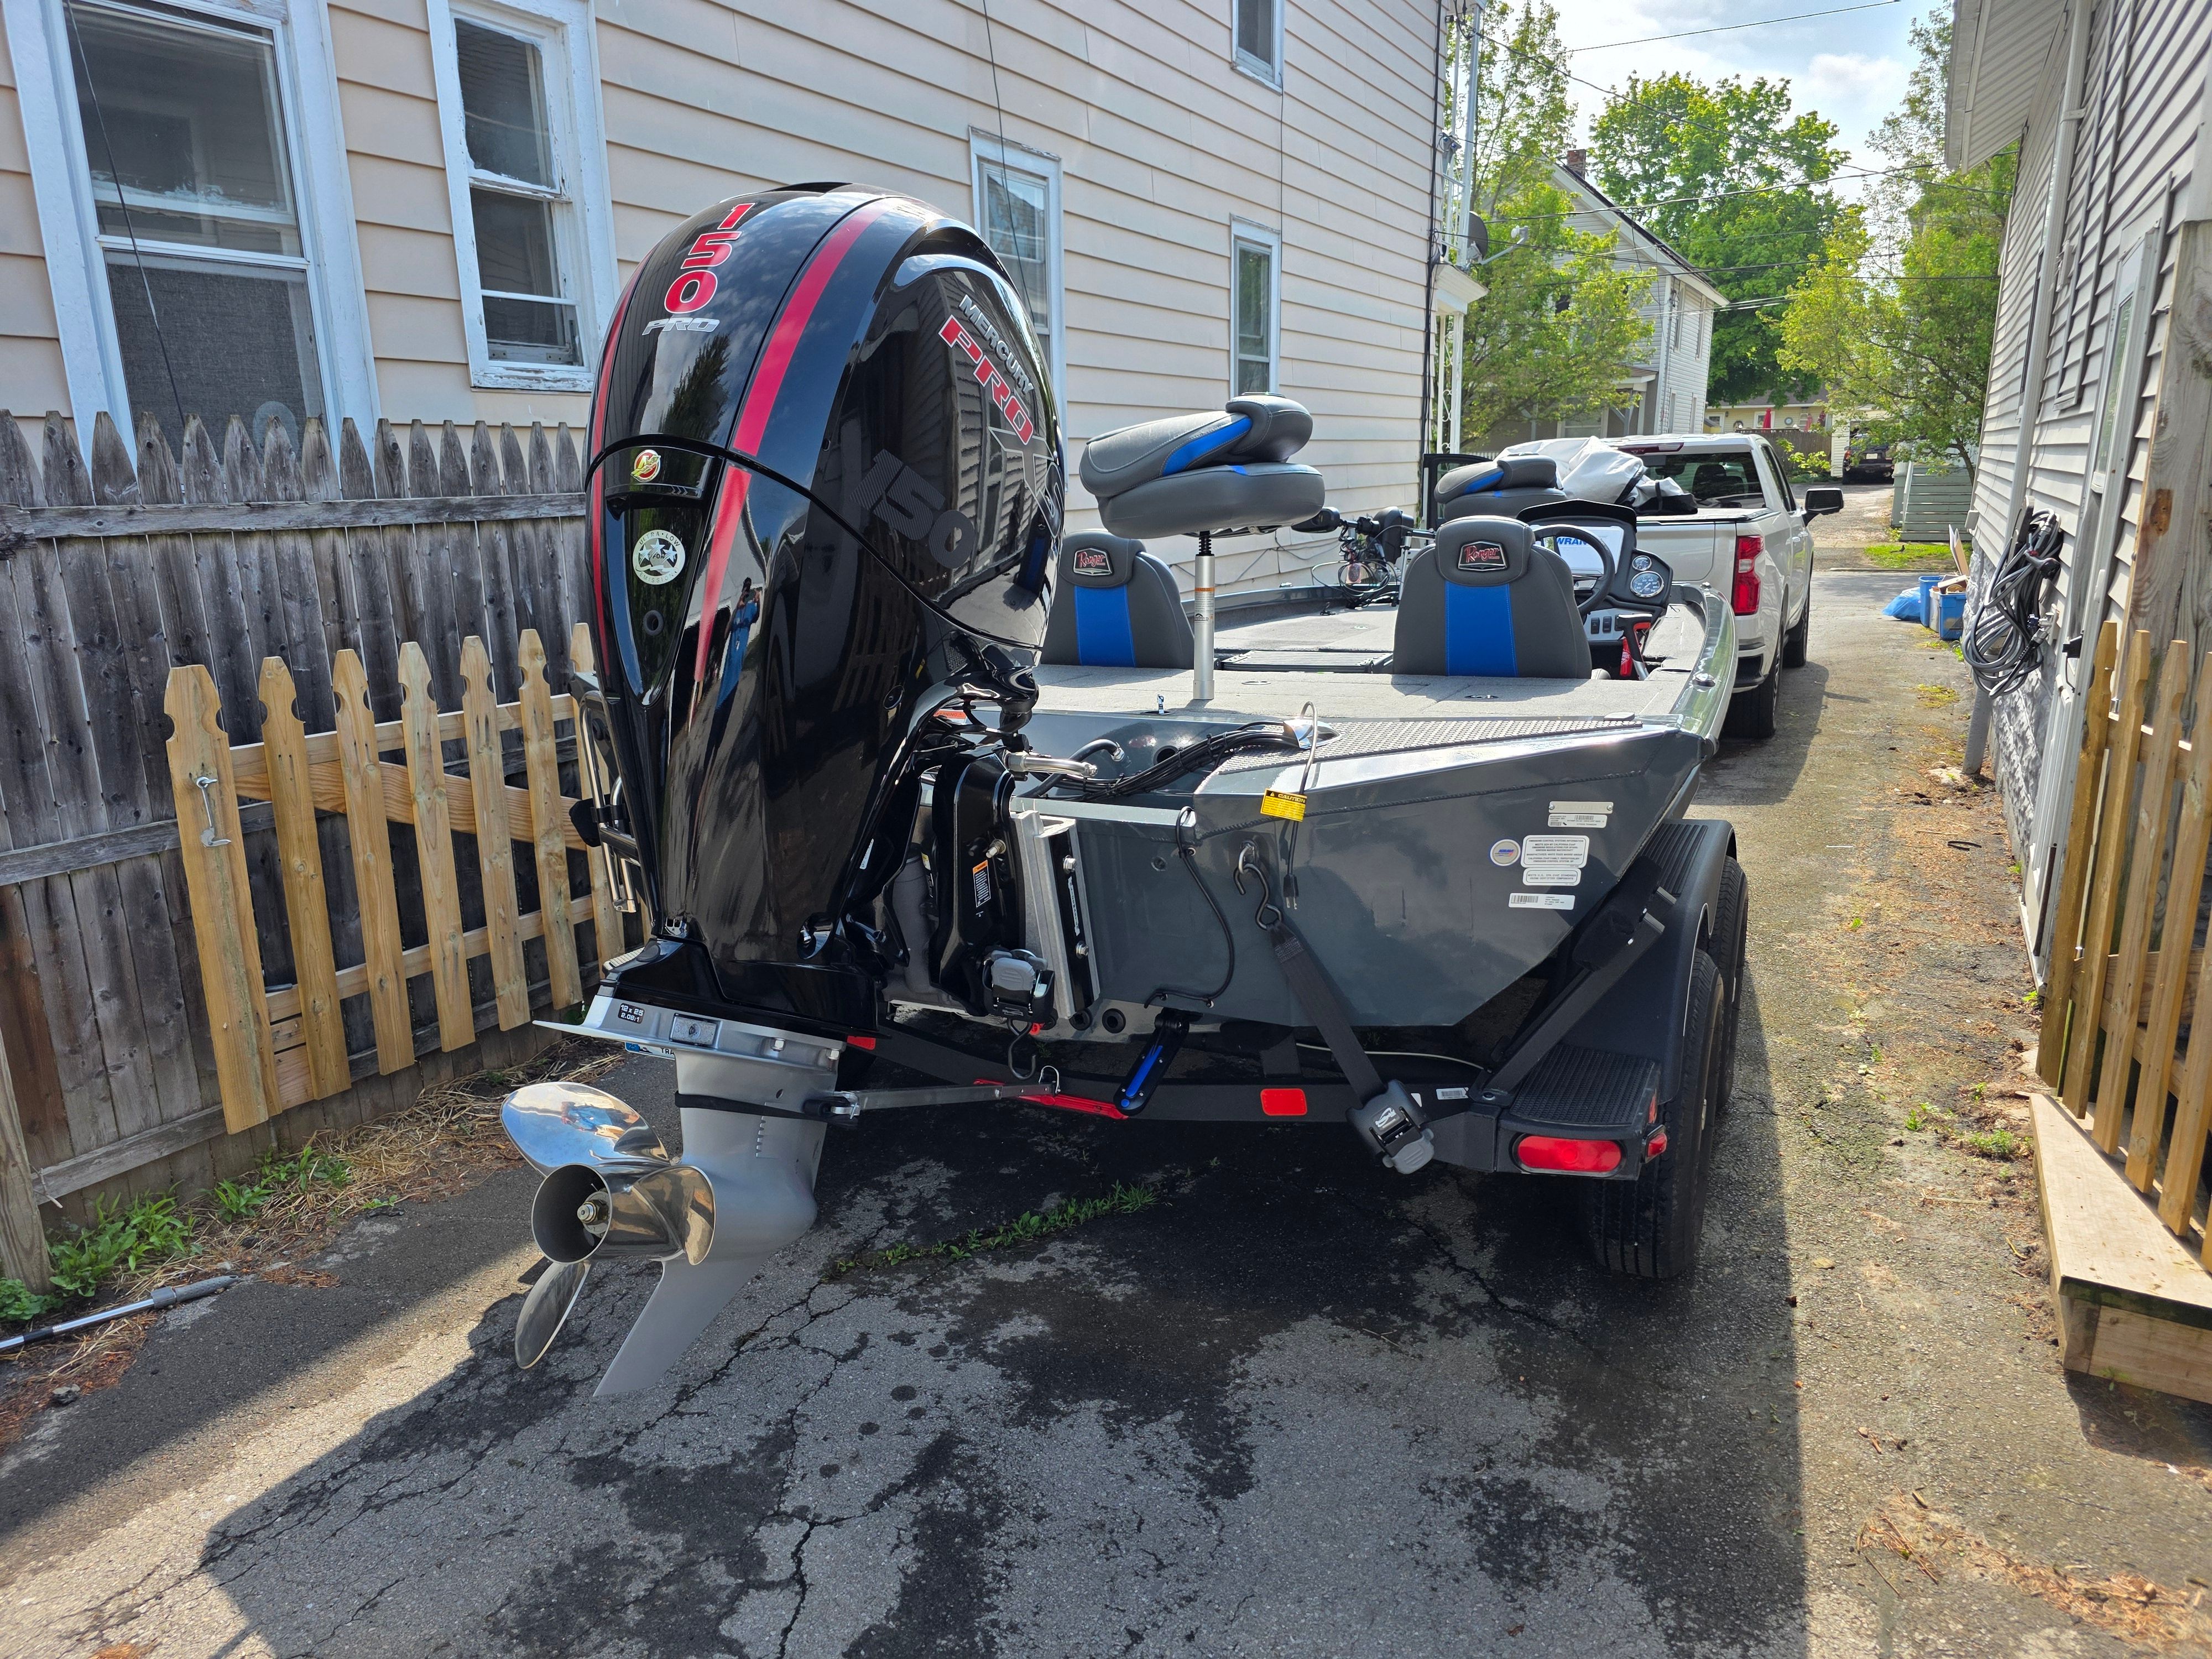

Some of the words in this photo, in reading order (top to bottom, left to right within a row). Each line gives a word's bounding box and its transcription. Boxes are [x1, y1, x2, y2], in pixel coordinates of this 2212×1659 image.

[664, 202, 756, 314] 150
[641, 317, 720, 336] PRO
[958, 294, 1034, 395] MERCURY
[938, 314, 1034, 446] PRO
[849, 448, 975, 570] 150
[1077, 551, 1107, 568] Ranger
[1464, 545, 1500, 563] Ranger
[1277, 794, 1306, 804] CAUTION
[620, 1012, 640, 1022] 2.08:1
[633, 1008, 644, 1016] 25
